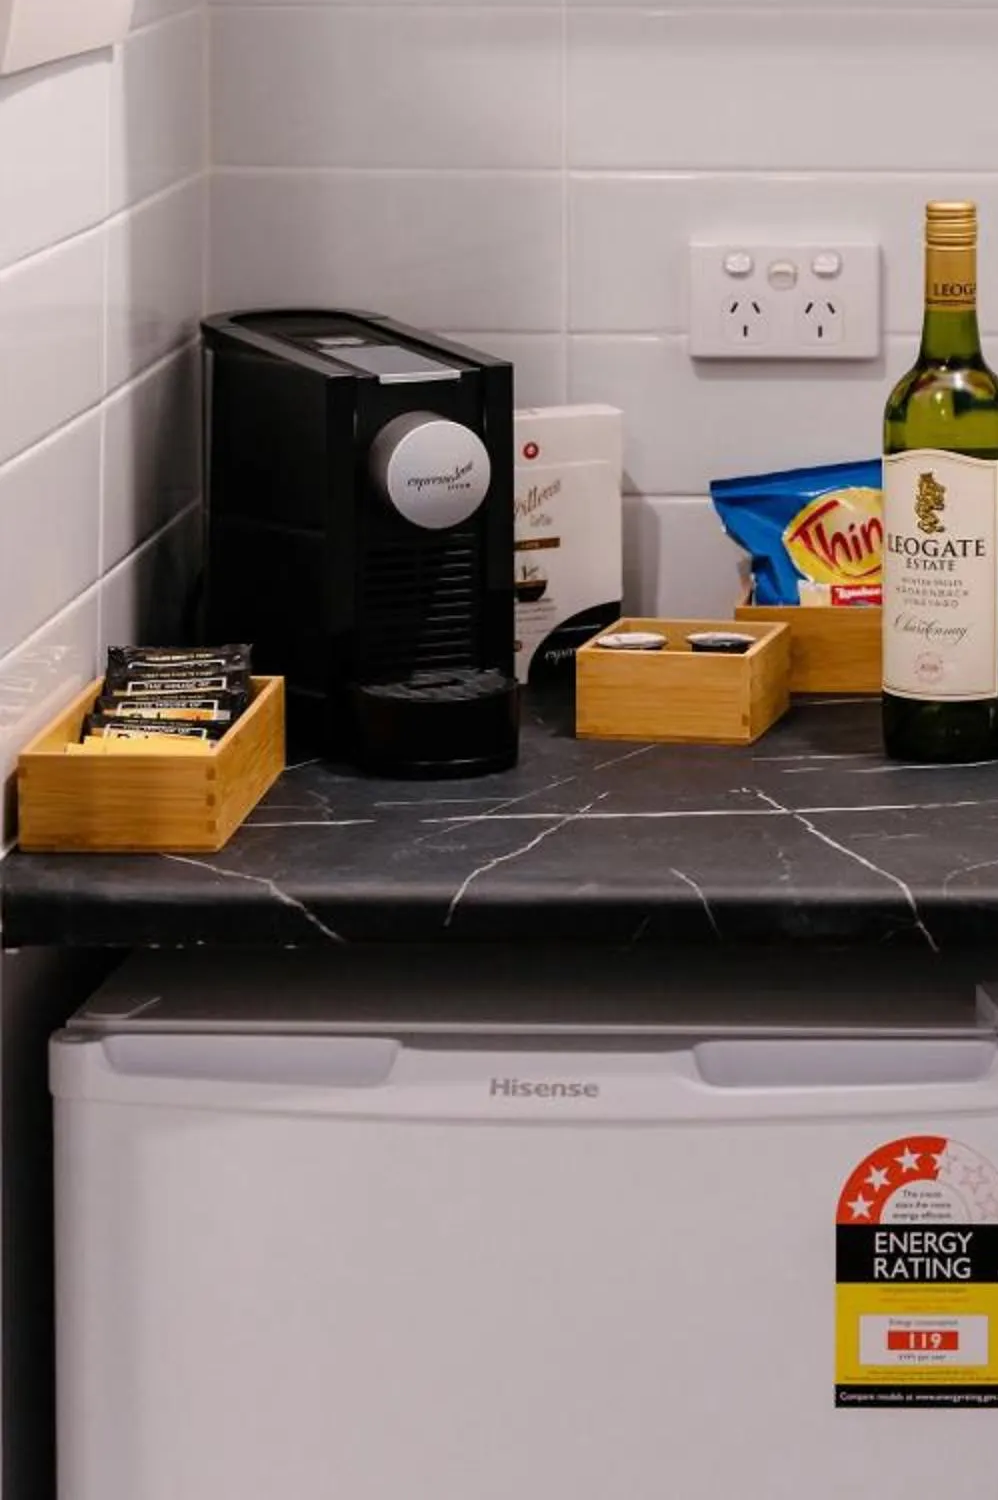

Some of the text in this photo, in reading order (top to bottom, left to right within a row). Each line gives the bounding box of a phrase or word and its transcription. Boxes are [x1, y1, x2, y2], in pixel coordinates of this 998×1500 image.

[887, 532, 986, 557] LEOGATE
[905, 557, 957, 572] ESTATE
[489, 1078, 599, 1098] Hisense
[874, 1231, 974, 1254] ENERGY
[873, 1257, 972, 1279] RATING
[908, 1332, 943, 1350] 119
